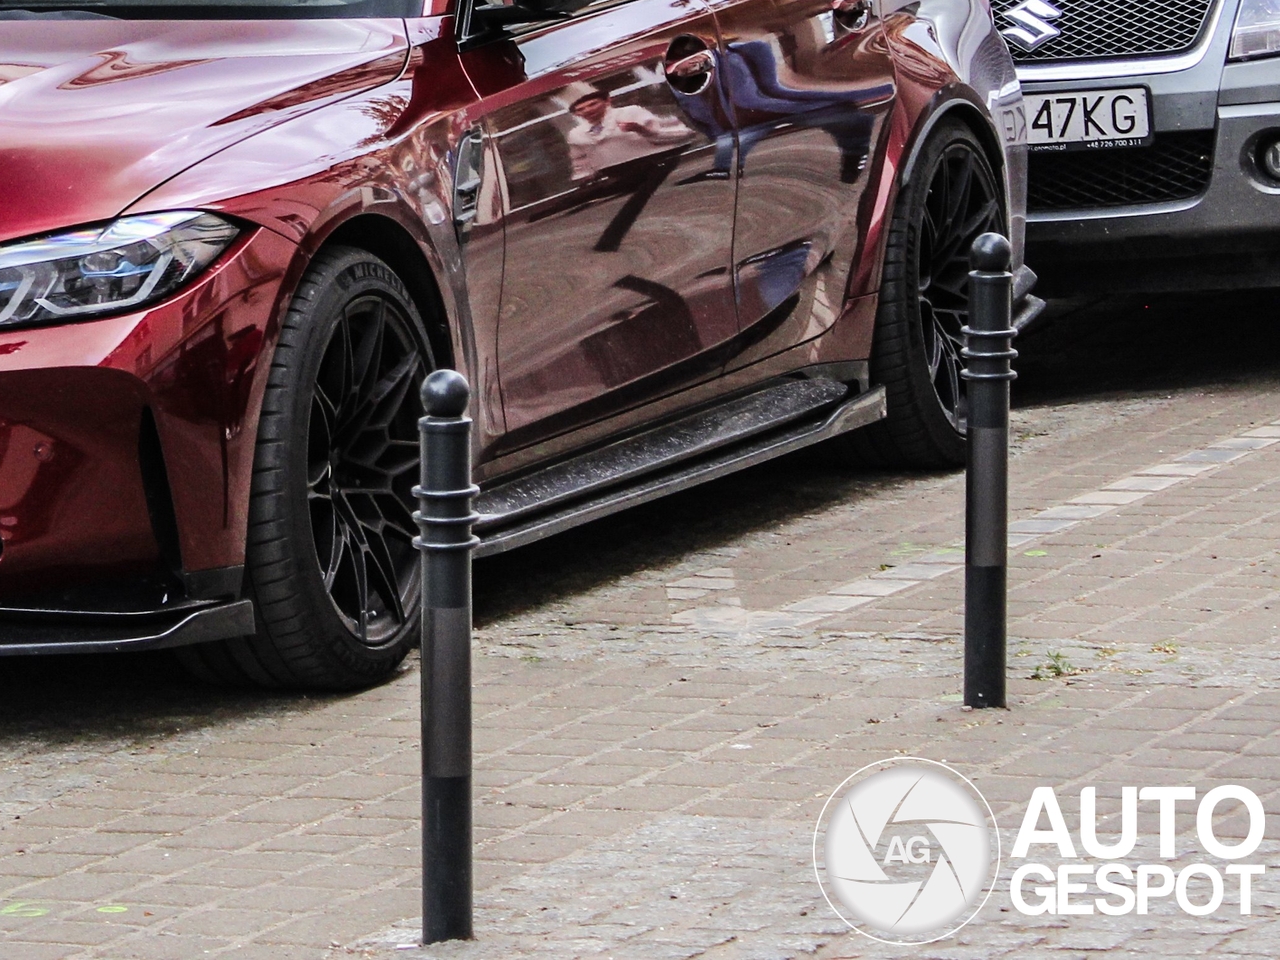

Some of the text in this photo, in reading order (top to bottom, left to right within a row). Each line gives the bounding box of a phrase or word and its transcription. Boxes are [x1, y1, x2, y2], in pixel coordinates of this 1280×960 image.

[1031, 95, 1137, 139] 47KG
[1100, 140, 1113, 148] 726
[1114, 139, 1127, 147] 700
[1129, 138, 1142, 146] 311
